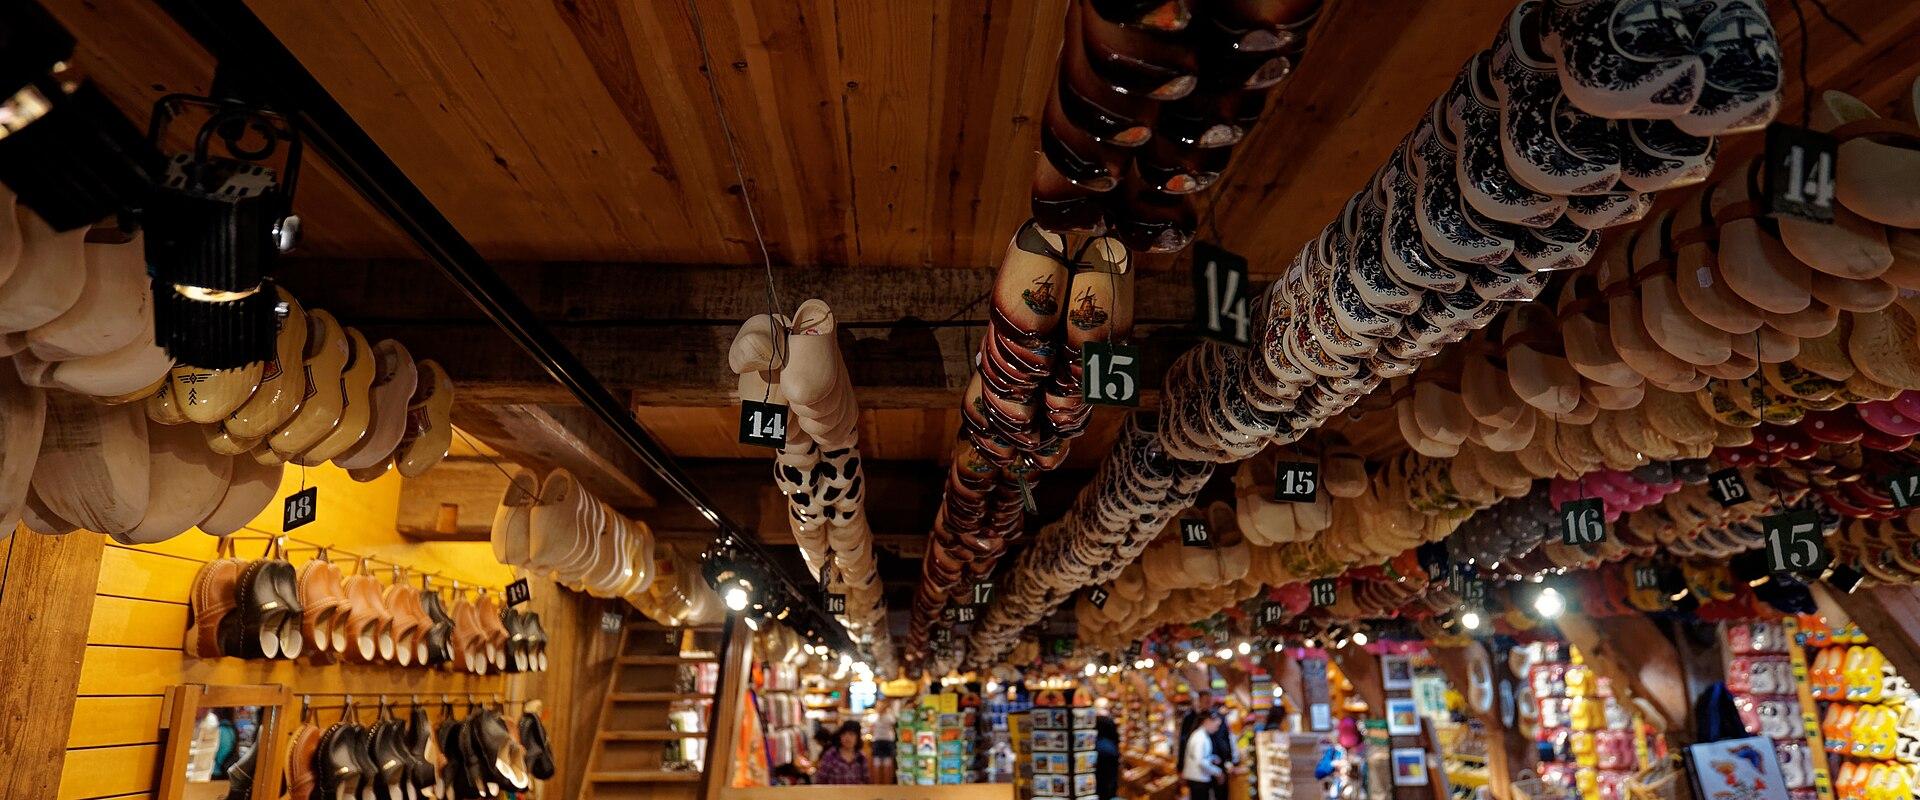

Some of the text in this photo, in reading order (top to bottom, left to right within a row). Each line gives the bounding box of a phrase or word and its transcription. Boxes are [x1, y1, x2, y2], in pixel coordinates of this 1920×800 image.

[1783, 145, 1835, 207] 14
[1204, 260, 1250, 343] 14
[1087, 353, 1134, 400] 15
[748, 411, 785, 439] 14
[1282, 470, 1315, 494] 15
[1717, 476, 1745, 501] 15
[286, 495, 312, 523] 18
[1186, 524, 1207, 541] 16
[1566, 508, 1603, 542] 16
[1768, 522, 1818, 570] 15
[828, 597, 844, 612] 16
[974, 583, 993, 604] 17
[1090, 589, 1106, 605] 17
[1313, 583, 1335, 606] 18
[959, 607, 974, 622] 18
[1266, 605, 1281, 622] 19
